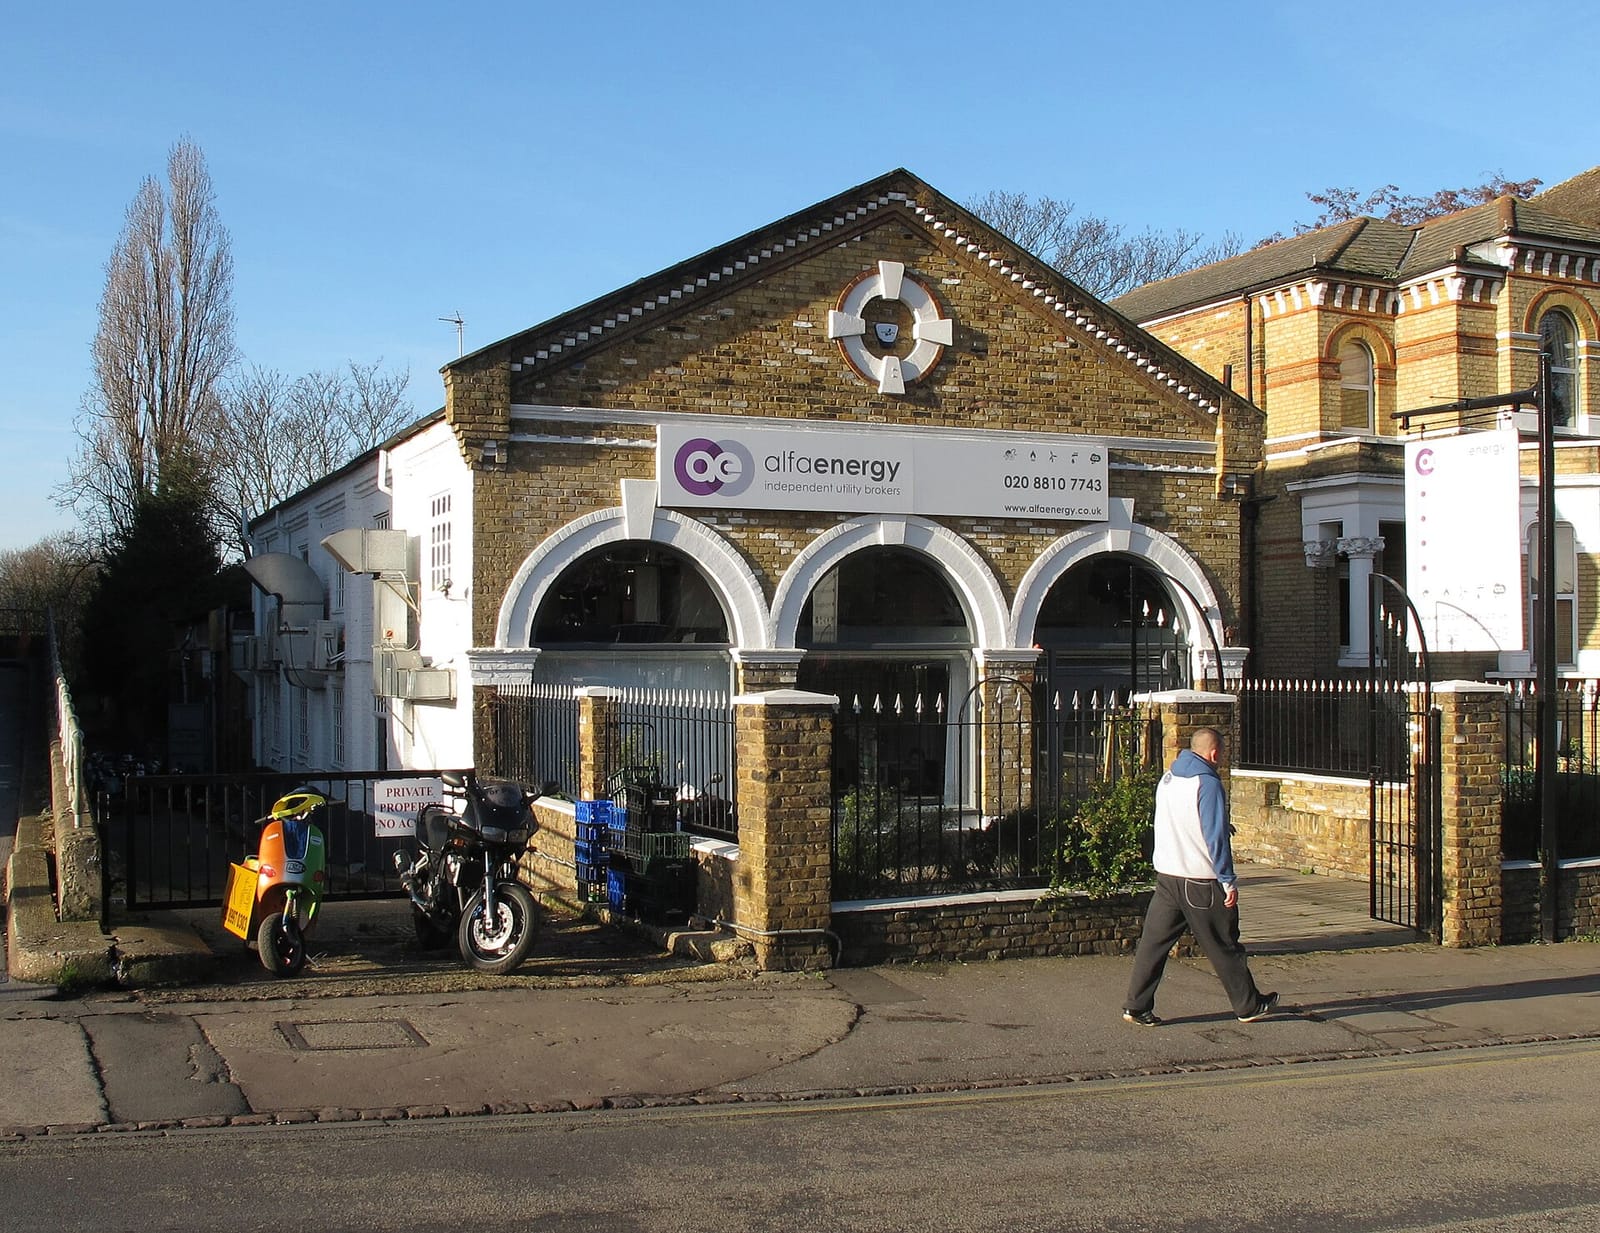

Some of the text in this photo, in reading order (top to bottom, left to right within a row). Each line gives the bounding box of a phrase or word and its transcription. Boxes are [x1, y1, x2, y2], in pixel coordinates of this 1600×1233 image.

[764, 450, 900, 482] alfaenergy
[764, 481, 901, 496] independent utility brokers
[1004, 475, 1102, 492] 020 8810 7743
[1004, 504, 1102, 516] www.alfaenergy.co.uk
[386, 786, 434, 798] PRIVATE
[378, 819, 395, 829] NO
